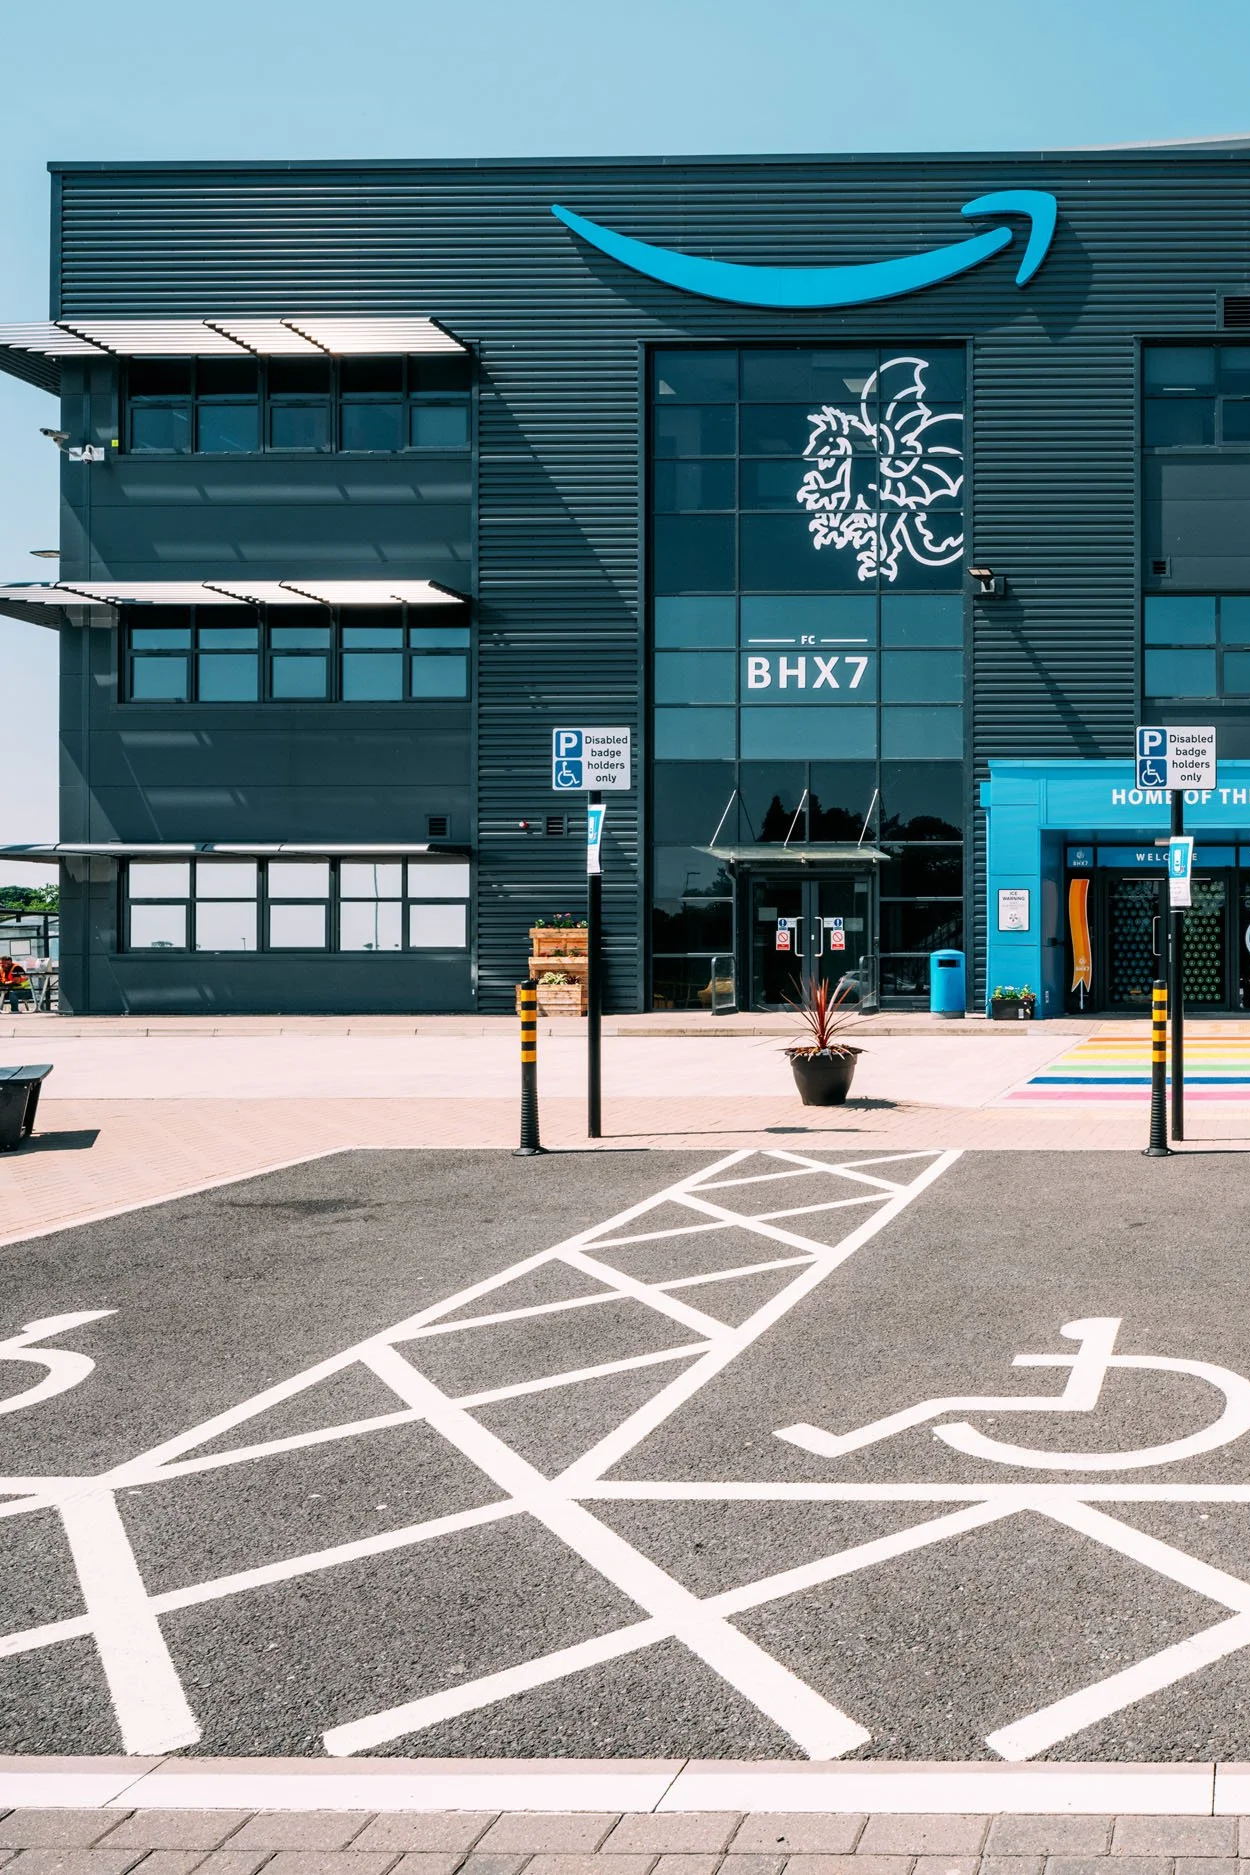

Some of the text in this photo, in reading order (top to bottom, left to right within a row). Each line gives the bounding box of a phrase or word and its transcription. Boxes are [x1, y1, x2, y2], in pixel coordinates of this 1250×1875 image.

[801, 635, 816, 644] FC
[748, 656, 868, 688] BHX7
[585, 736, 628, 744] Disabled
[1144, 731, 1162, 755] P
[1169, 735, 1213, 743] Disabled
[560, 732, 578, 756] P
[591, 748, 621, 758] badge
[1176, 748, 1206, 757] badge
[588, 761, 625, 770] holders
[1172, 760, 1210, 768] holders
[596, 774, 616, 784] only
[1180, 773, 1202, 782] only
[1112, 789, 1172, 805] HOME
[1184, 790, 1212, 805] OF
[1136, 853, 1198, 861] WELCE
